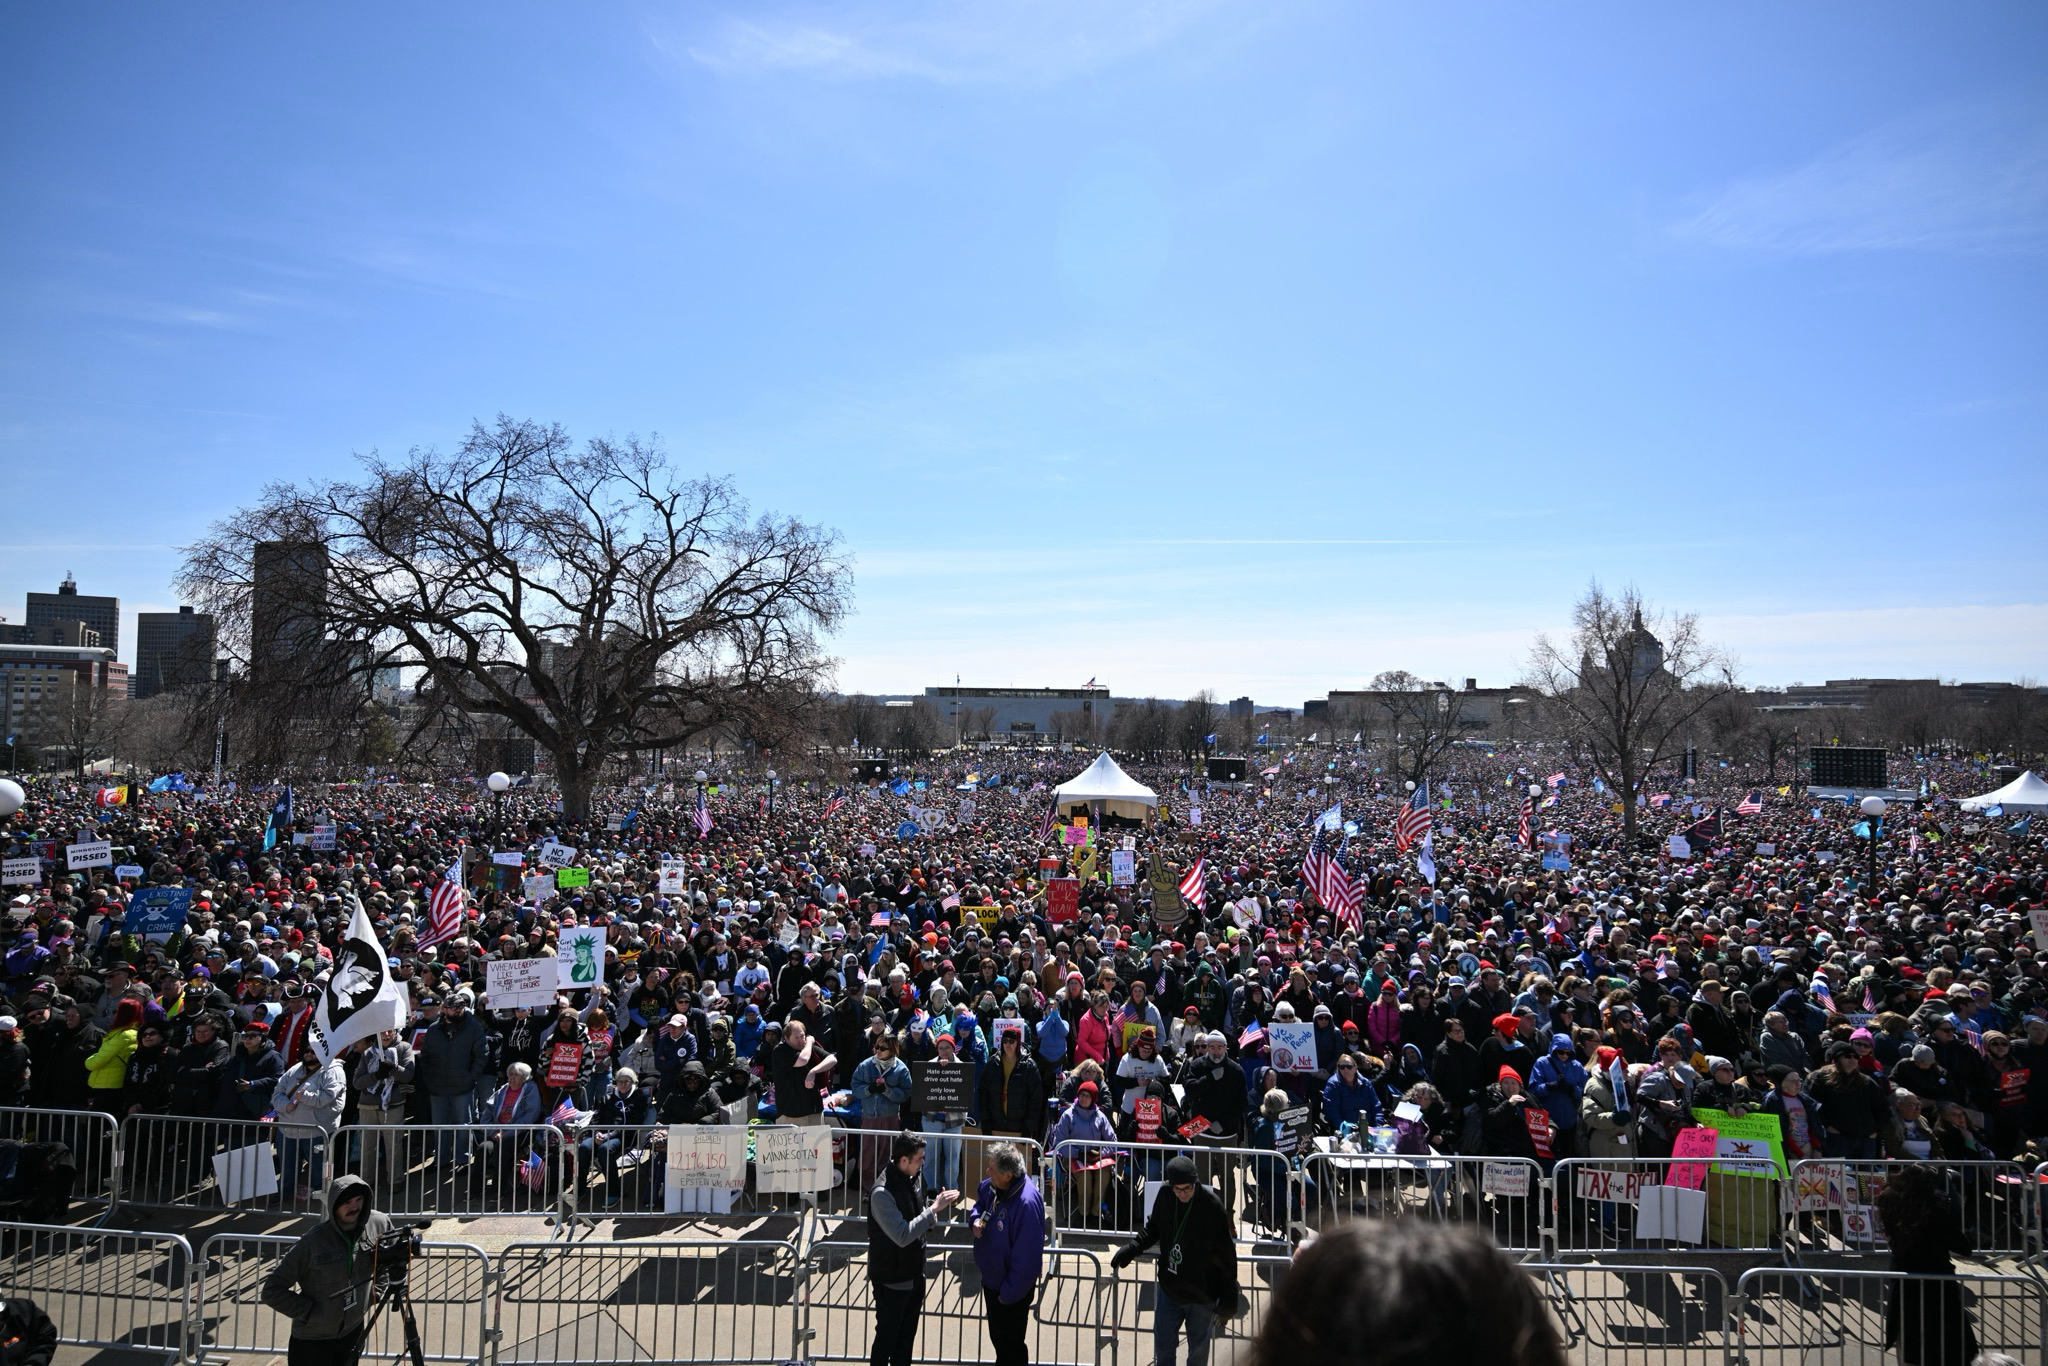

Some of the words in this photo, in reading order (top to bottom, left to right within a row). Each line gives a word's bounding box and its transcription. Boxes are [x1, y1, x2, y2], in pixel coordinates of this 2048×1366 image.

[72, 852, 107, 862] PISSED
[551, 848, 564, 856] NO
[149, 890, 189, 898] EXISTING
[977, 909, 999, 918] LOCK
[132, 924, 139, 932] A
[147, 922, 177, 931] CRIME
[490, 962, 514, 972] WHEN
[497, 971, 512, 980] LIKE
[492, 980, 504, 988] THE
[501, 984, 514, 992] THE
[520, 980, 541, 990] LEADERS
[1270, 1028, 1287, 1041] We
[1281, 1033, 1295, 1044] the
[1290, 1031, 1312, 1050] People
[1298, 1055, 1312, 1066] Not
[1754, 1115, 1778, 1124] SCARED
[1717, 1120, 1757, 1129] DIVERSITY
[1759, 1123, 1773, 1131] BUT
[1682, 1131, 1696, 1142] THE
[1700, 1134, 1715, 1145] ONLY
[1728, 1130, 1775, 1139] DICTATORSHIP
[766, 1132, 807, 1148] PROJECT
[762, 1148, 818, 1164] MINNESOTA!
[680, 1178, 709, 1187] EPSTEIN
[711, 1180, 722, 1188] WAS
[1578, 1171, 1612, 1200] TAX
[1608, 1182, 1624, 1193] the
